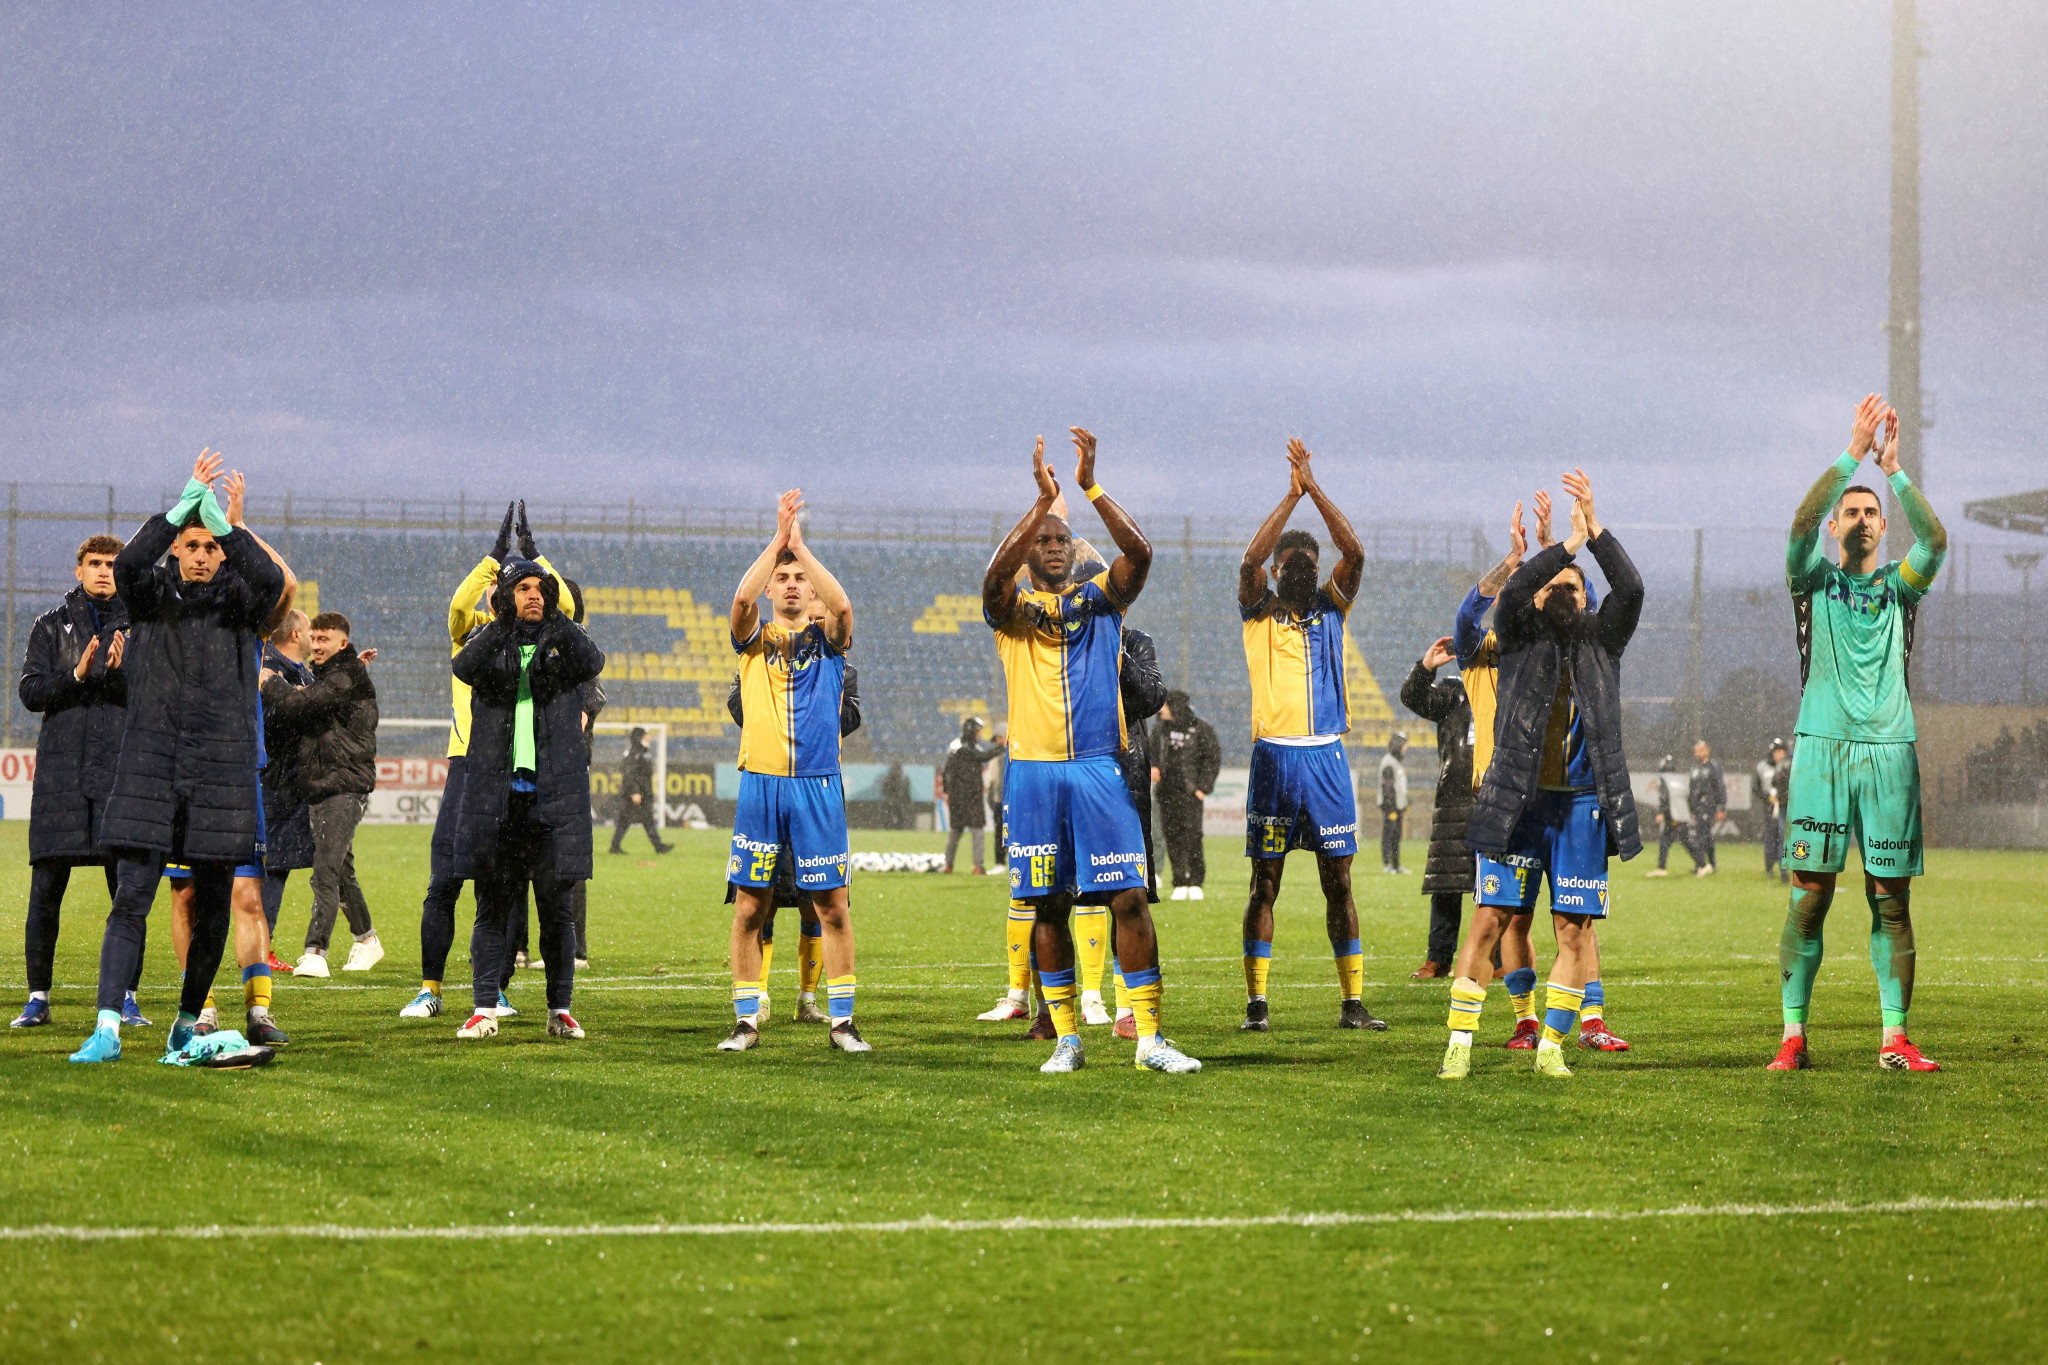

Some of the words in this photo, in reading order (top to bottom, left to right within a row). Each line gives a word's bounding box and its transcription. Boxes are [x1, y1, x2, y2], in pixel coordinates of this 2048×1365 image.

[736, 839, 782, 854] avance
[1262, 825, 1286, 853] 26
[1010, 843, 1058, 858] avance
[1823, 833, 1831, 864] 1
[798, 852, 848, 868] badounas
[1091, 851, 1145, 866] badounas
[1869, 855, 1895, 867] .com
[750, 852, 777, 881] 29
[1031, 855, 1055, 888] 69
[801, 872, 827, 883] .com
[1094, 870, 1123, 883] .com
[1515, 867, 1528, 898] 7
[1557, 894, 1583, 906] .com
